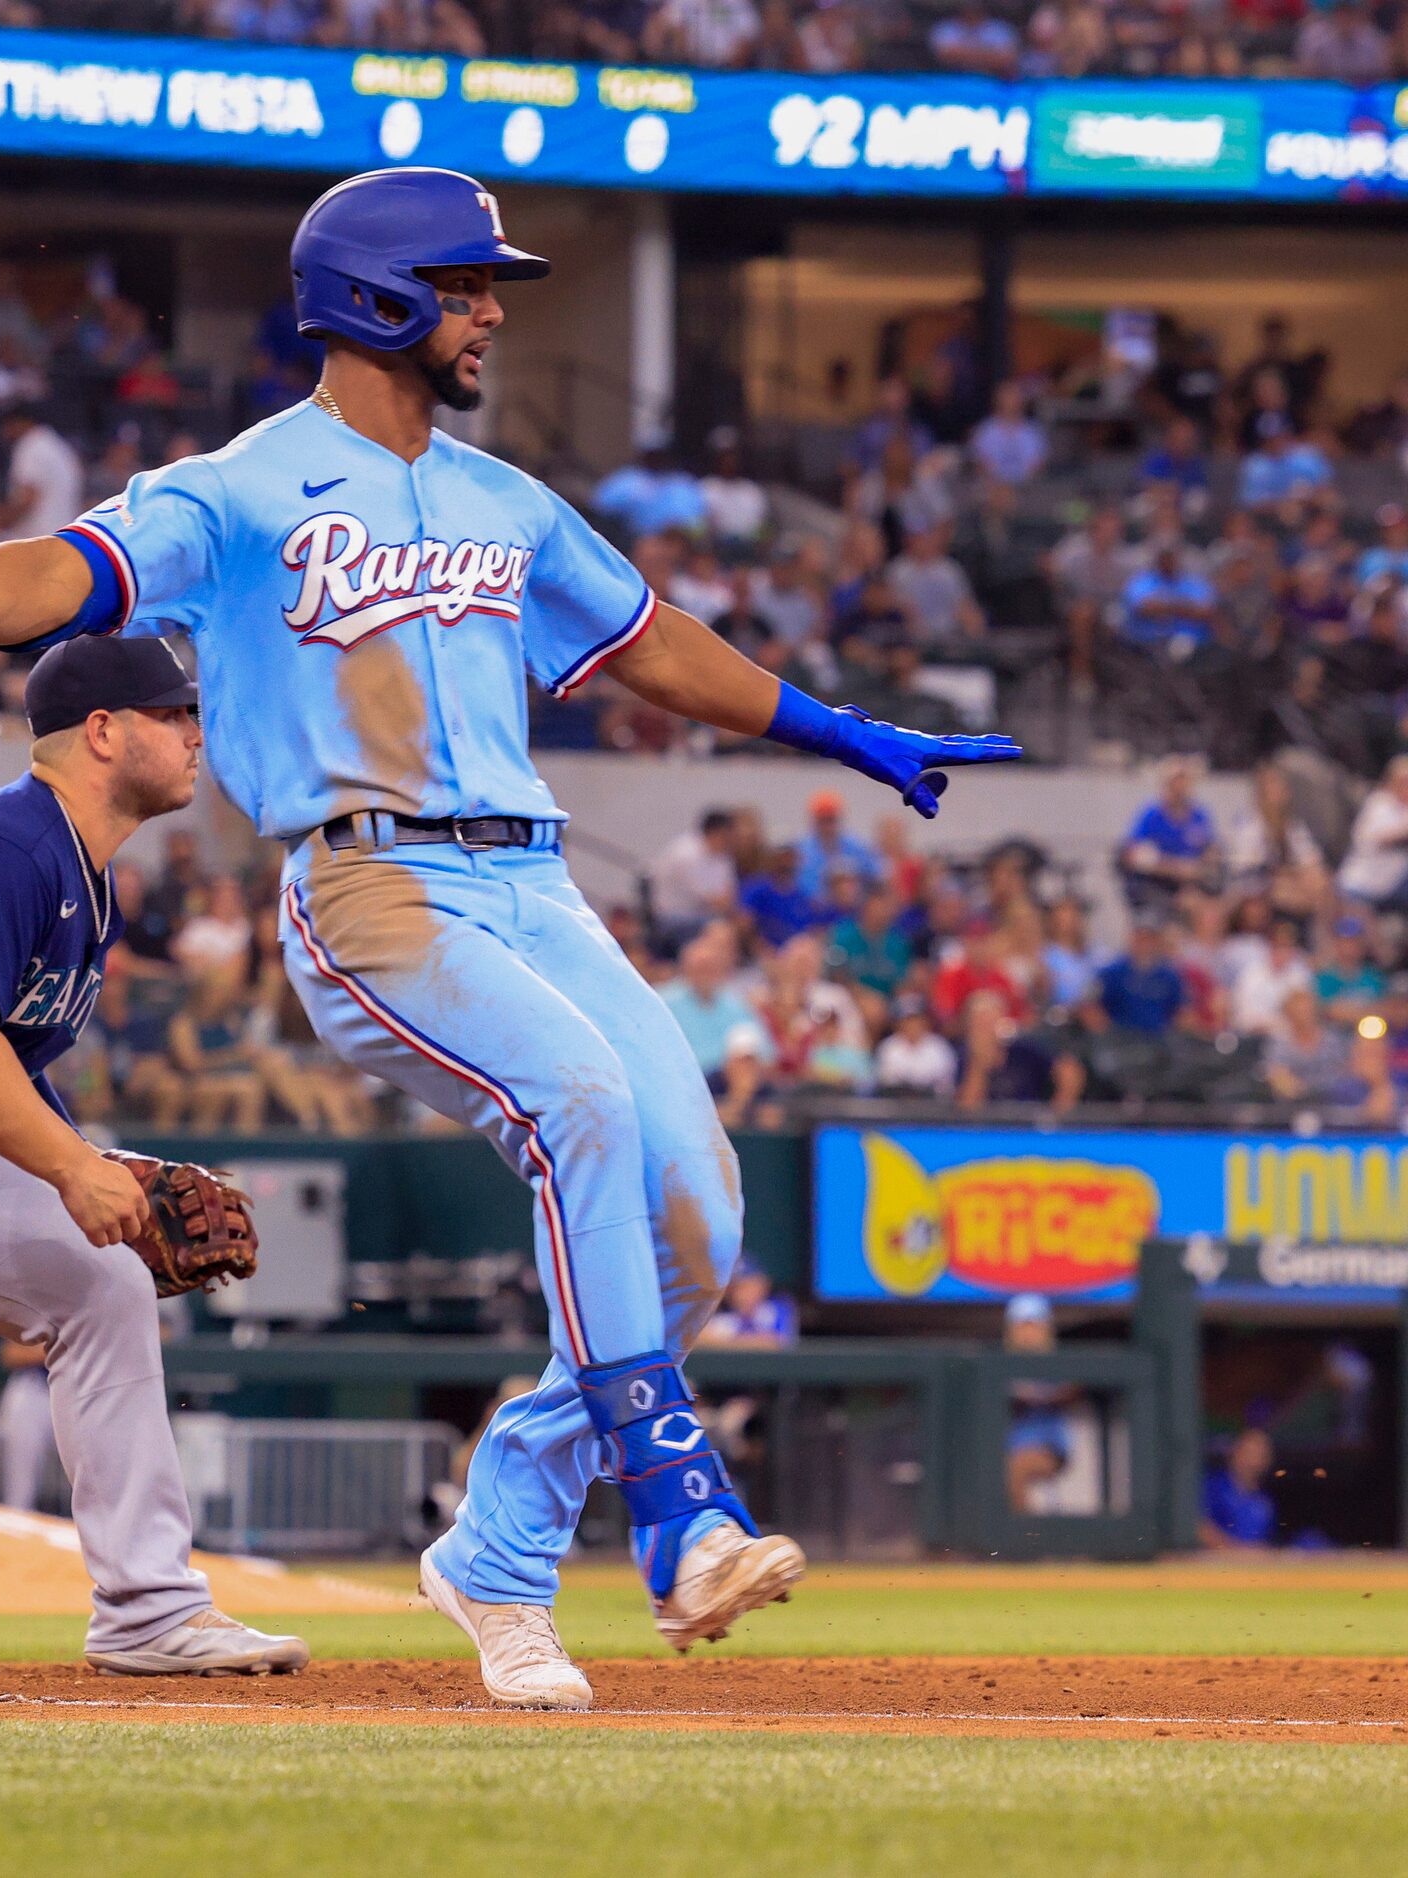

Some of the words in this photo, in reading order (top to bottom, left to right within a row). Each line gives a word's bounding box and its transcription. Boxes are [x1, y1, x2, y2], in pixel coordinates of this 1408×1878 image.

[167, 69, 324, 138] FESTA
[379, 100, 423, 160] 0
[502, 107, 545, 167] 0
[624, 115, 669, 174] 0
[769, 94, 864, 168] 92
[865, 104, 1030, 171] MPH
[280, 510, 536, 630] Ranger
